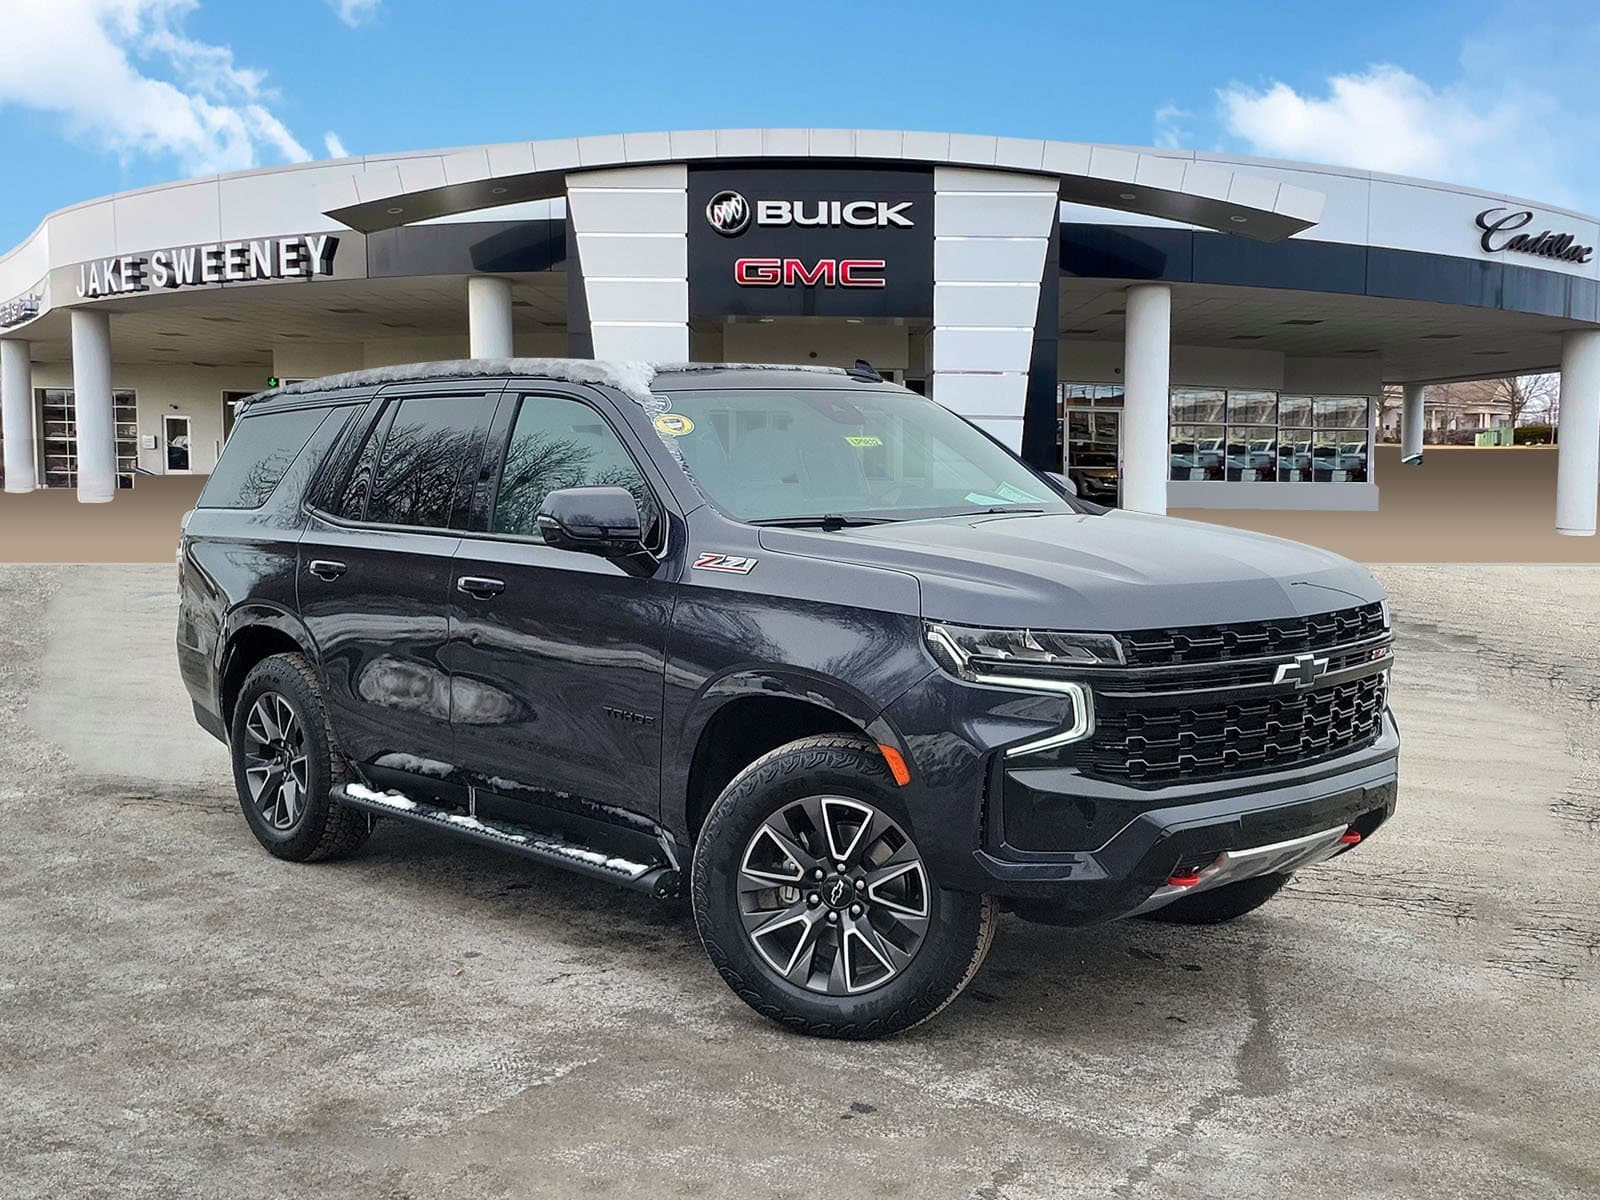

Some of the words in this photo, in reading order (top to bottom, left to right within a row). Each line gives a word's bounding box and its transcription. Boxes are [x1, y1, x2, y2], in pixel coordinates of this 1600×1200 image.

[757, 200, 915, 226] BUICK
[1475, 207, 1594, 264] Cadillac
[76, 256, 140, 297] JAKE
[152, 235, 332, 288] SWEENEY
[735, 257, 886, 287] GMC
